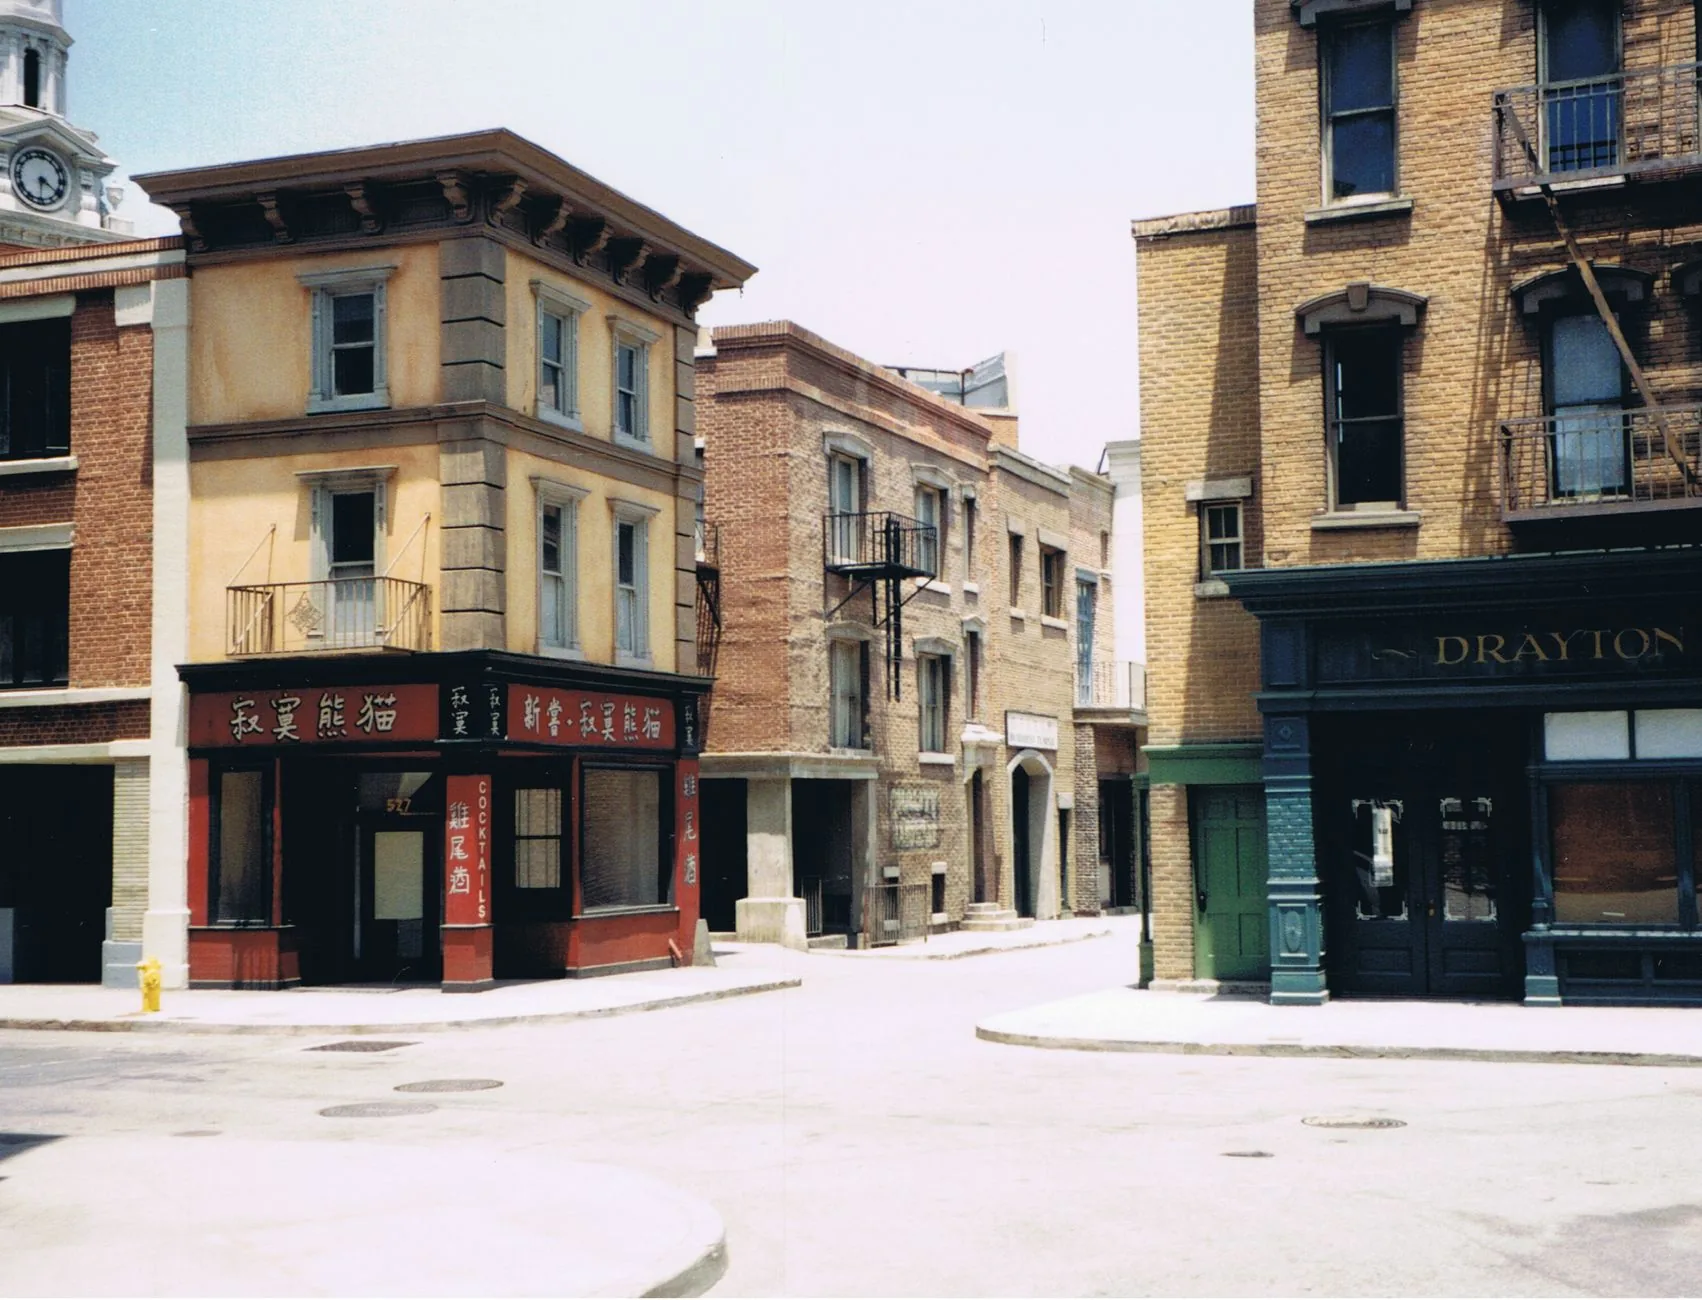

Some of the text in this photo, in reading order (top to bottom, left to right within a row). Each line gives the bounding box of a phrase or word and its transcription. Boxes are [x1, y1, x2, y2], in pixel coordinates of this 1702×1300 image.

[1433, 626, 1684, 666] DRAYTON
[229, 692, 398, 741] 寂寞熊猫
[386, 798, 412, 812] 527
[478, 781, 487, 919] COCKTAILS
